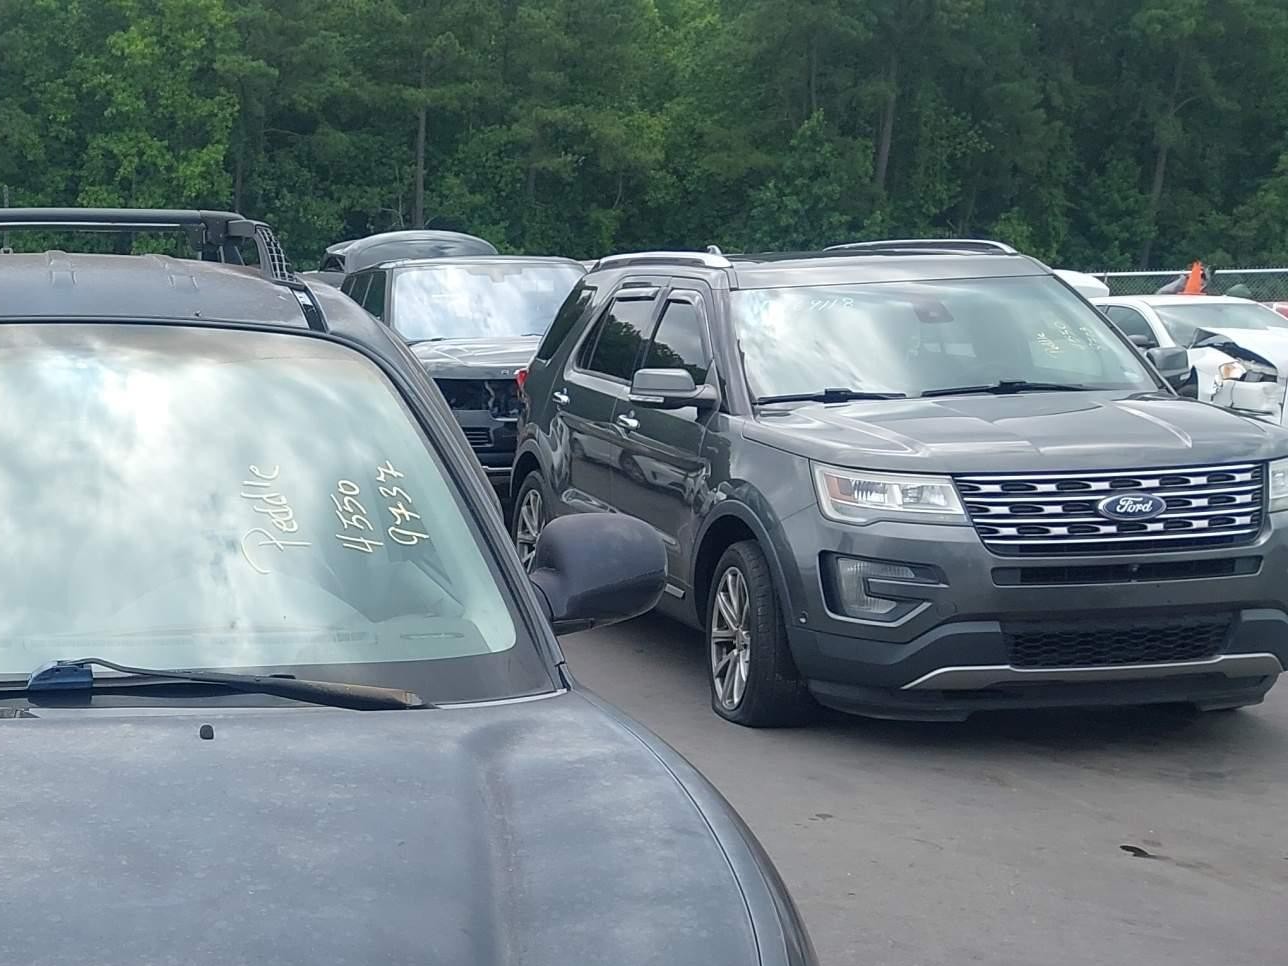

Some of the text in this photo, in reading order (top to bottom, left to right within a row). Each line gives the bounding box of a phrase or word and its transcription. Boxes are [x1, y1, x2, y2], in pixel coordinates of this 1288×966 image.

[330, 479, 385, 553] 4550
[375, 460, 430, 546] 9737
[1116, 497, 1153, 513] Ford
